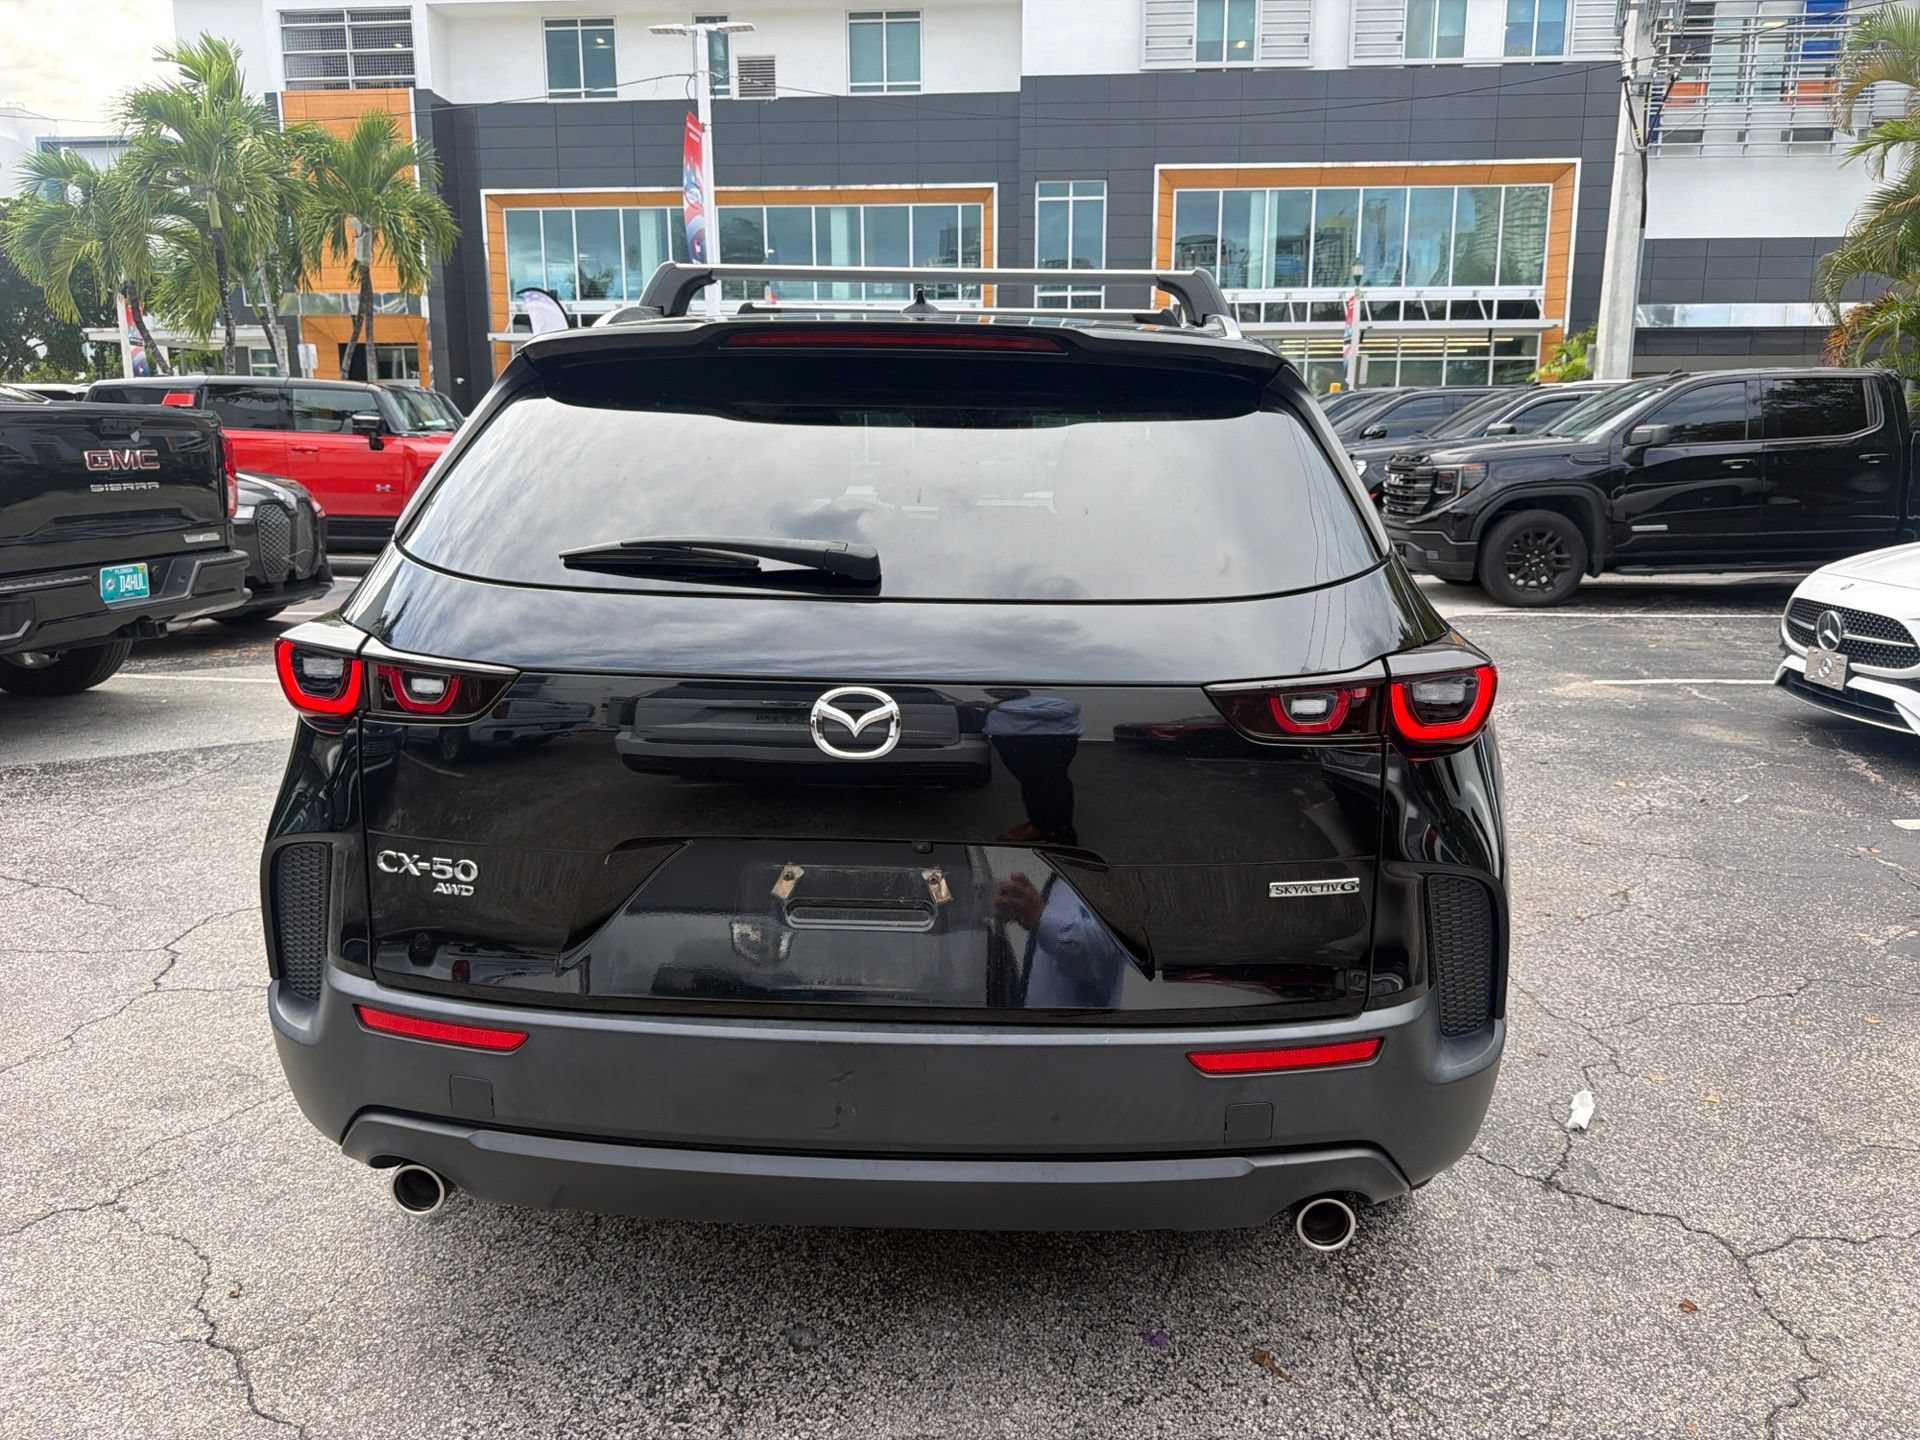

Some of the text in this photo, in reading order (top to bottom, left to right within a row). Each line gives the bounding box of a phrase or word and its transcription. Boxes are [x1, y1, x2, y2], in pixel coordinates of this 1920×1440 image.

[84, 449, 160, 471] GMC
[90, 481, 160, 493] SIERRA
[119, 572, 147, 593] D4HUL
[376, 849, 479, 882] CX-50
[433, 882, 475, 897] AWD
